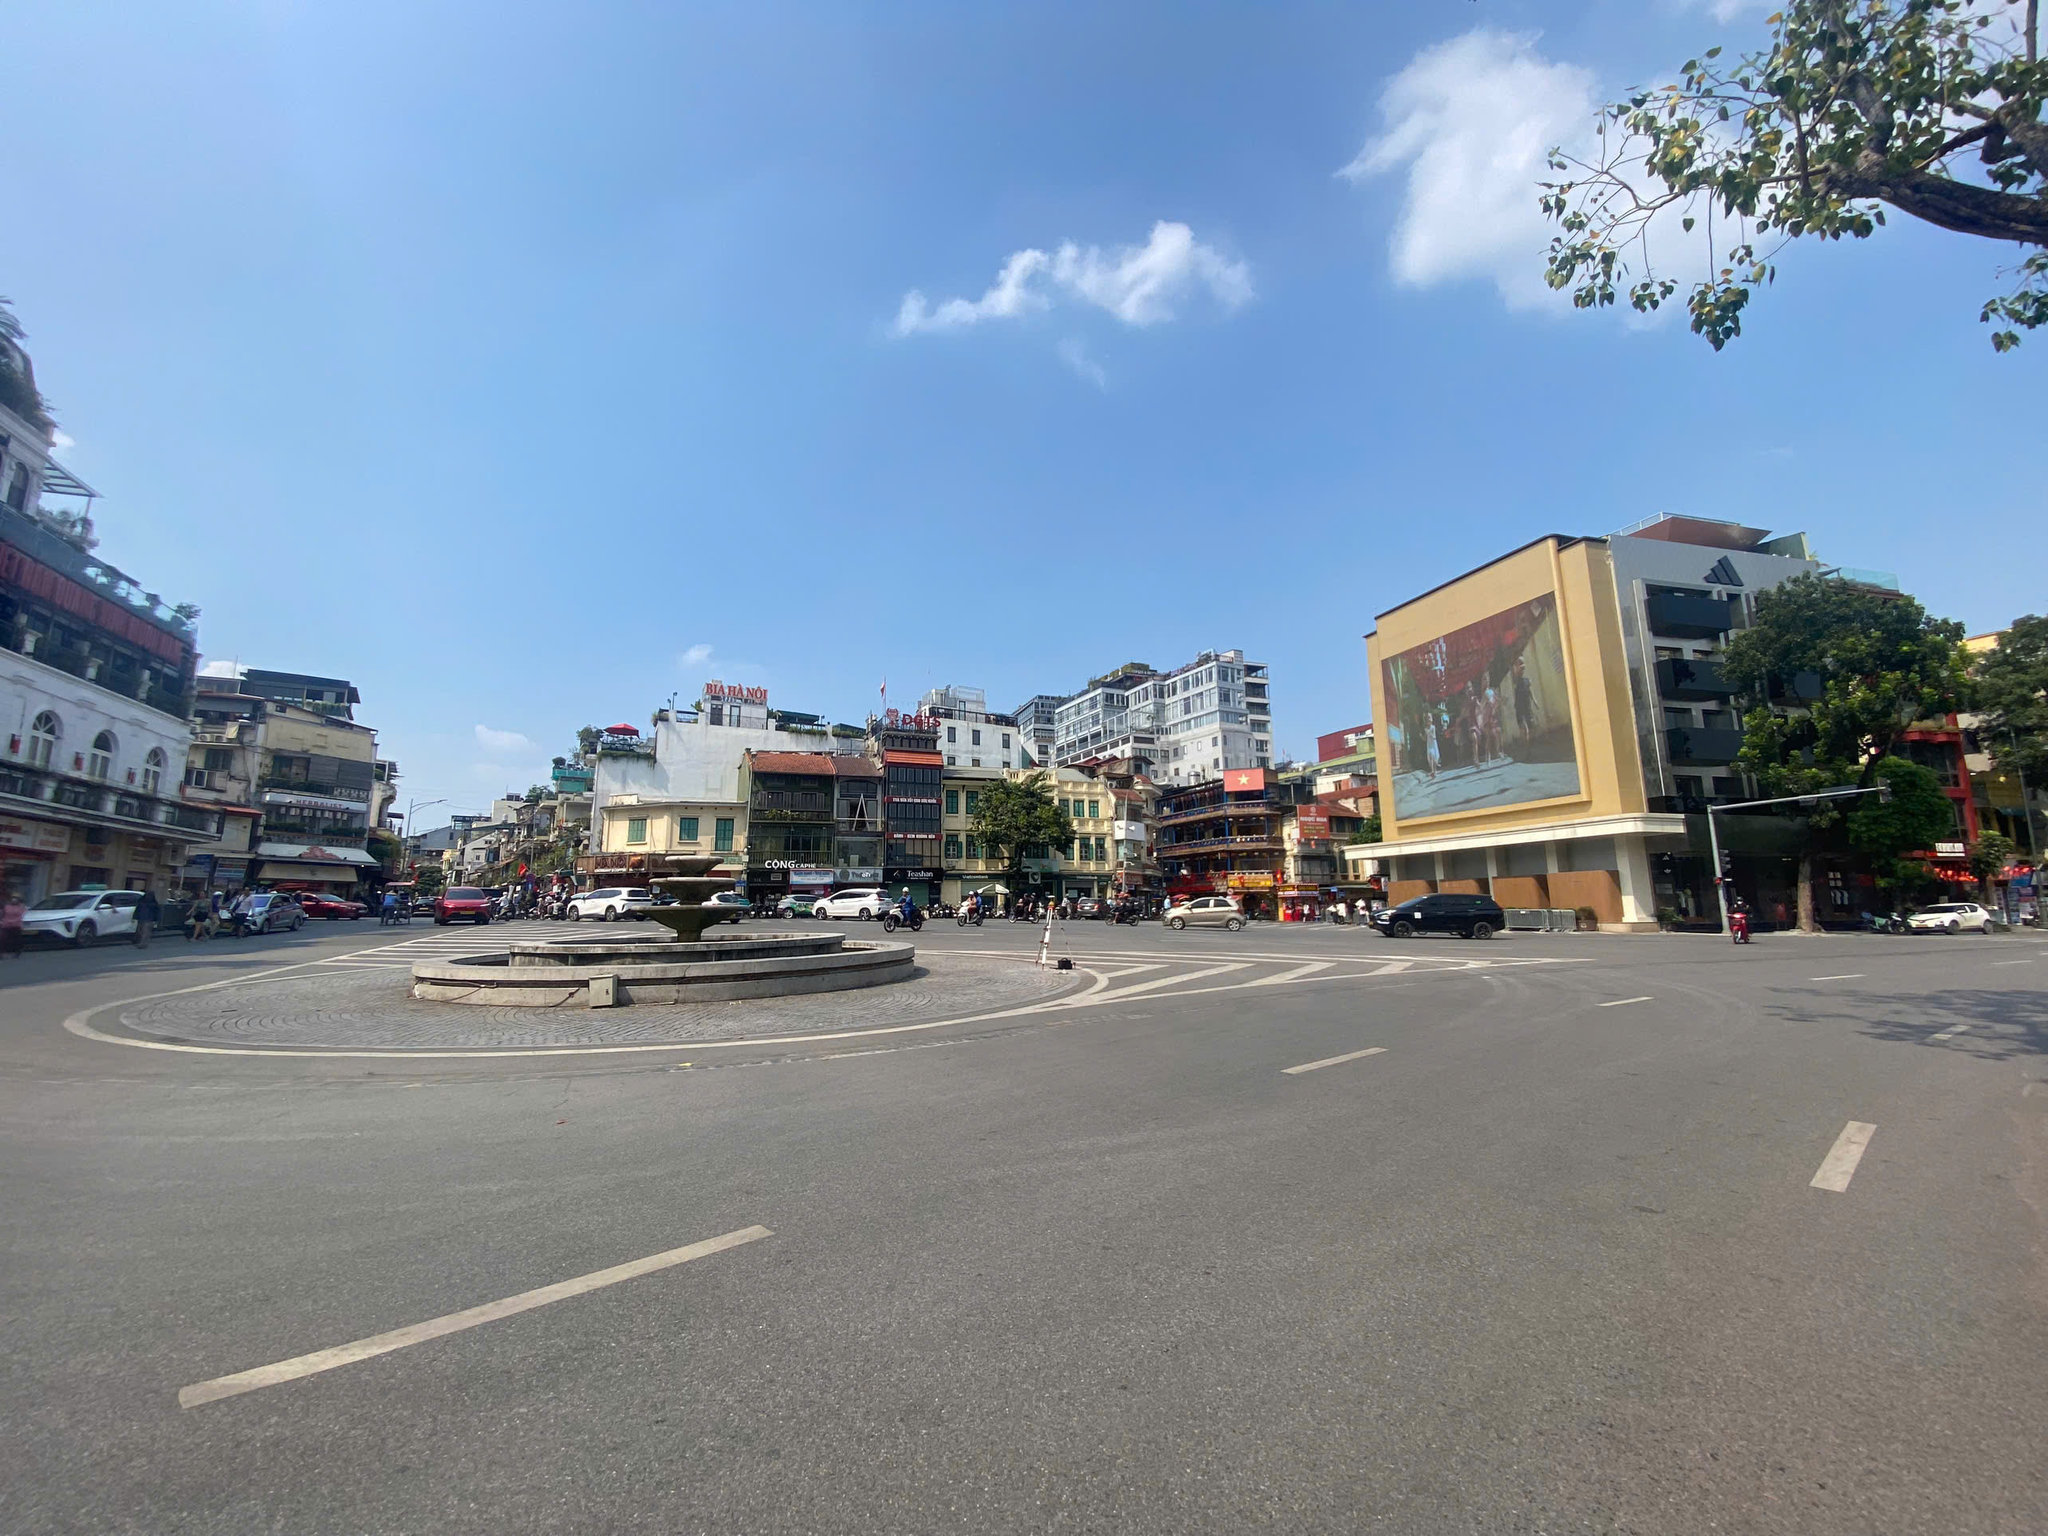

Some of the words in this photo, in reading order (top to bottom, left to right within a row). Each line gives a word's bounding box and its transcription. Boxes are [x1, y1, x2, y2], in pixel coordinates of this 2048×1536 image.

[706, 683, 725, 695] BIA
[727, 683, 744, 697] HÀ
[765, 859, 795, 870] CỘNG
